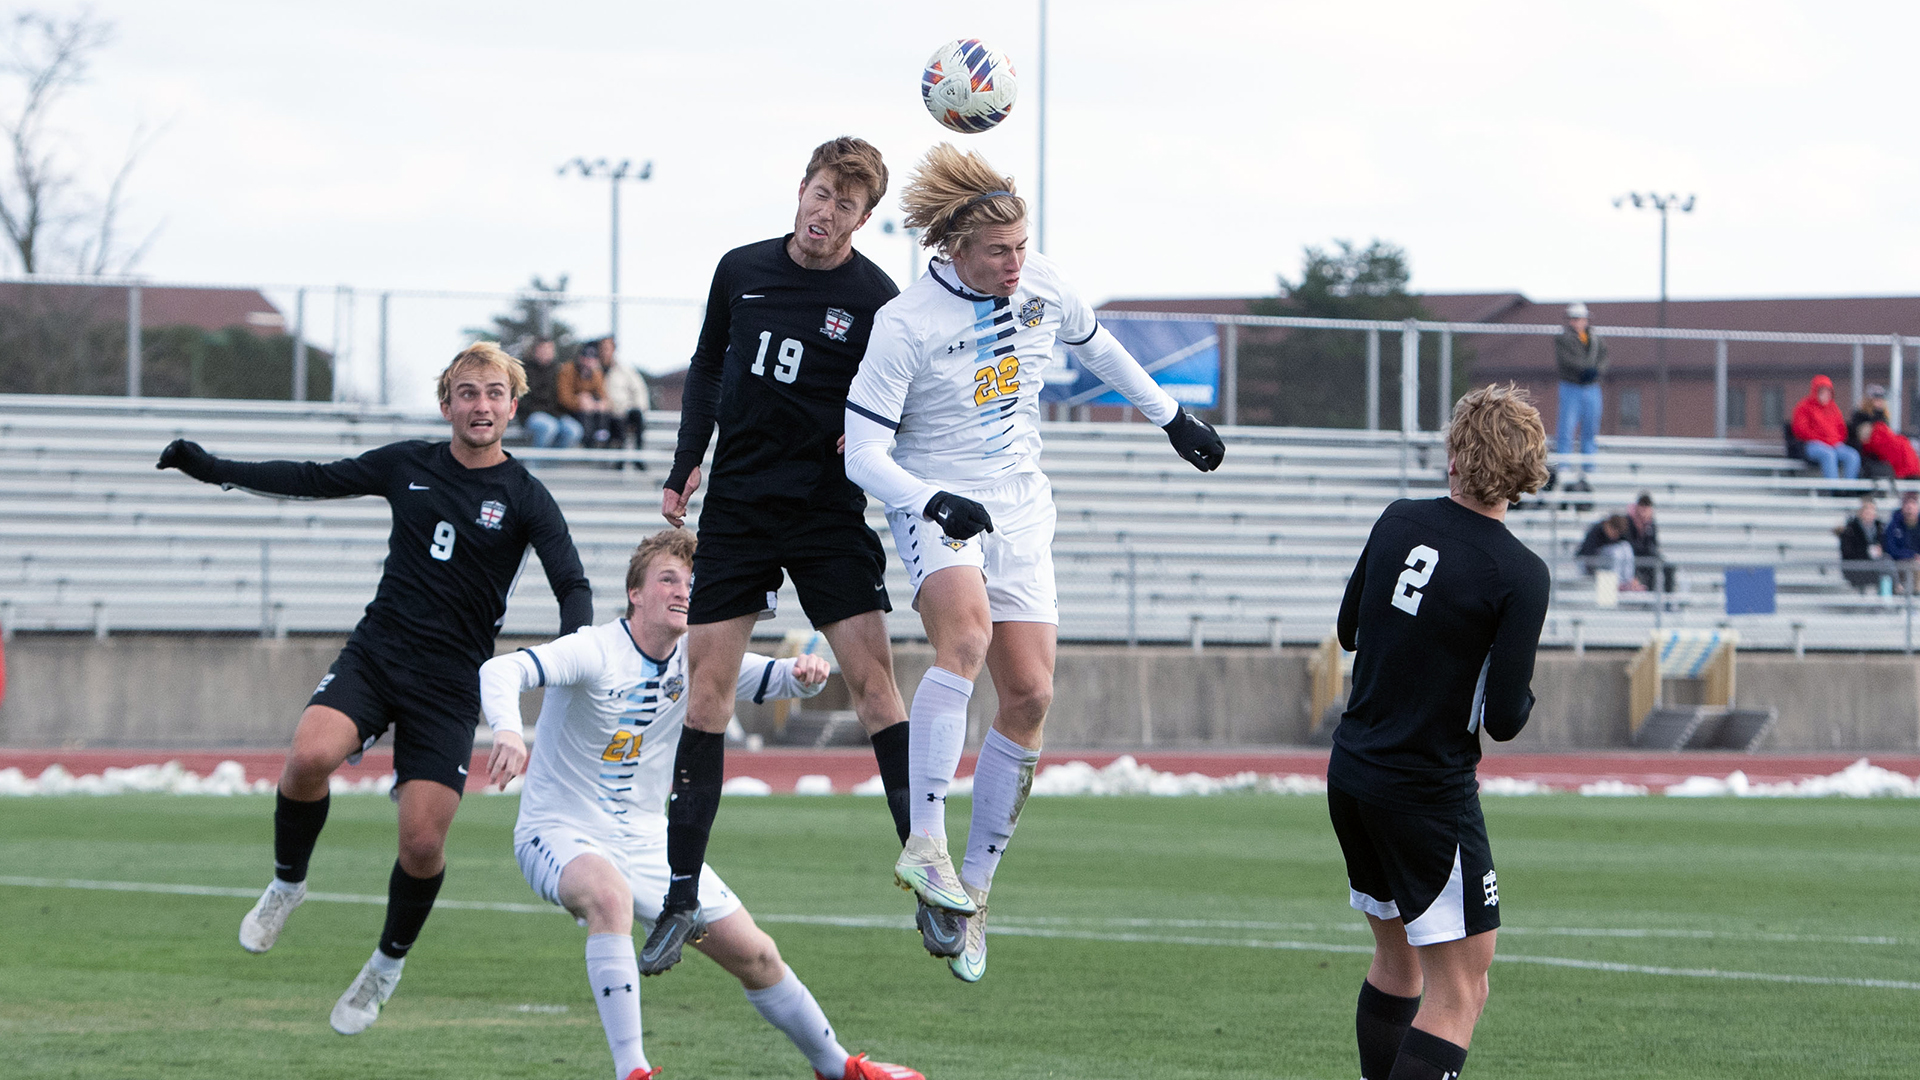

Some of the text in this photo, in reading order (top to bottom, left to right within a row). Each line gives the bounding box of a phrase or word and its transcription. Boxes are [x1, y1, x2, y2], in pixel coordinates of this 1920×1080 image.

[751, 330, 804, 384] 19
[974, 355, 1021, 407] 22
[430, 520, 456, 561] 9
[1391, 544, 1439, 617] 2
[601, 729, 643, 762] 21
